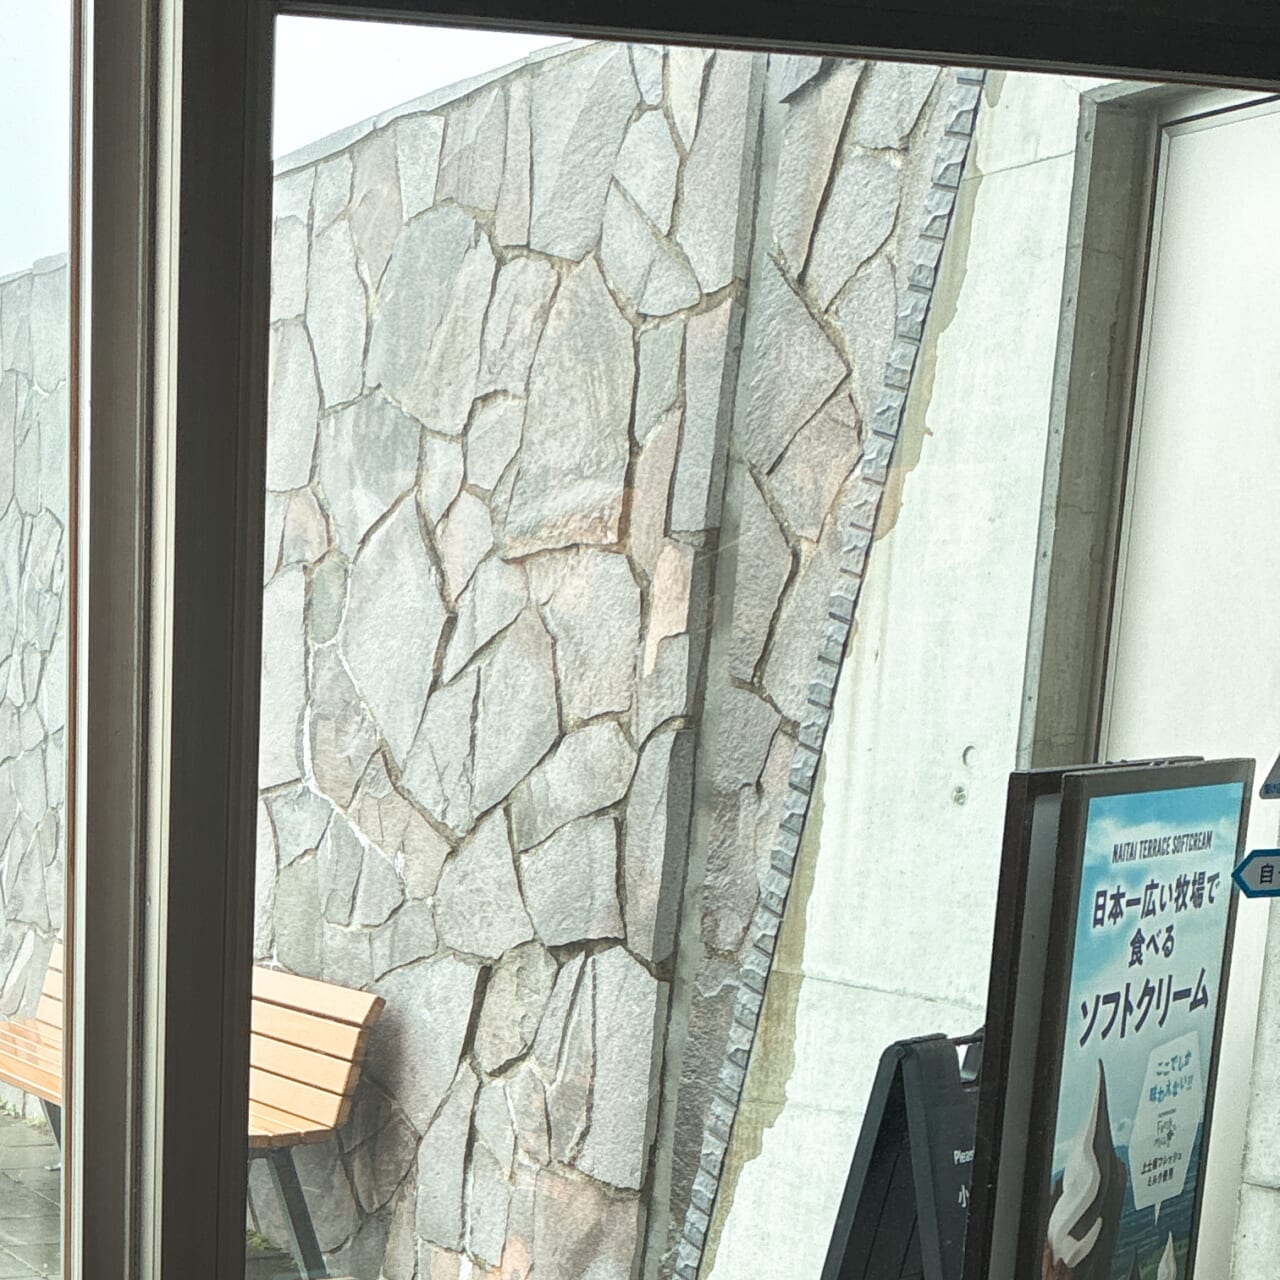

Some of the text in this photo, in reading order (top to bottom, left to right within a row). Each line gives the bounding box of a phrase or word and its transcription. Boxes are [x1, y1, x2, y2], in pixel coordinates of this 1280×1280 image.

[1111, 830, 1213, 864] NAITAI TERRACE SOFTCREAM
[1092, 871, 1221, 928] 日本一広い牧場で
[1128, 924, 1175, 968] 食べる
[1079, 967, 1209, 1048] ソフトクリーム
